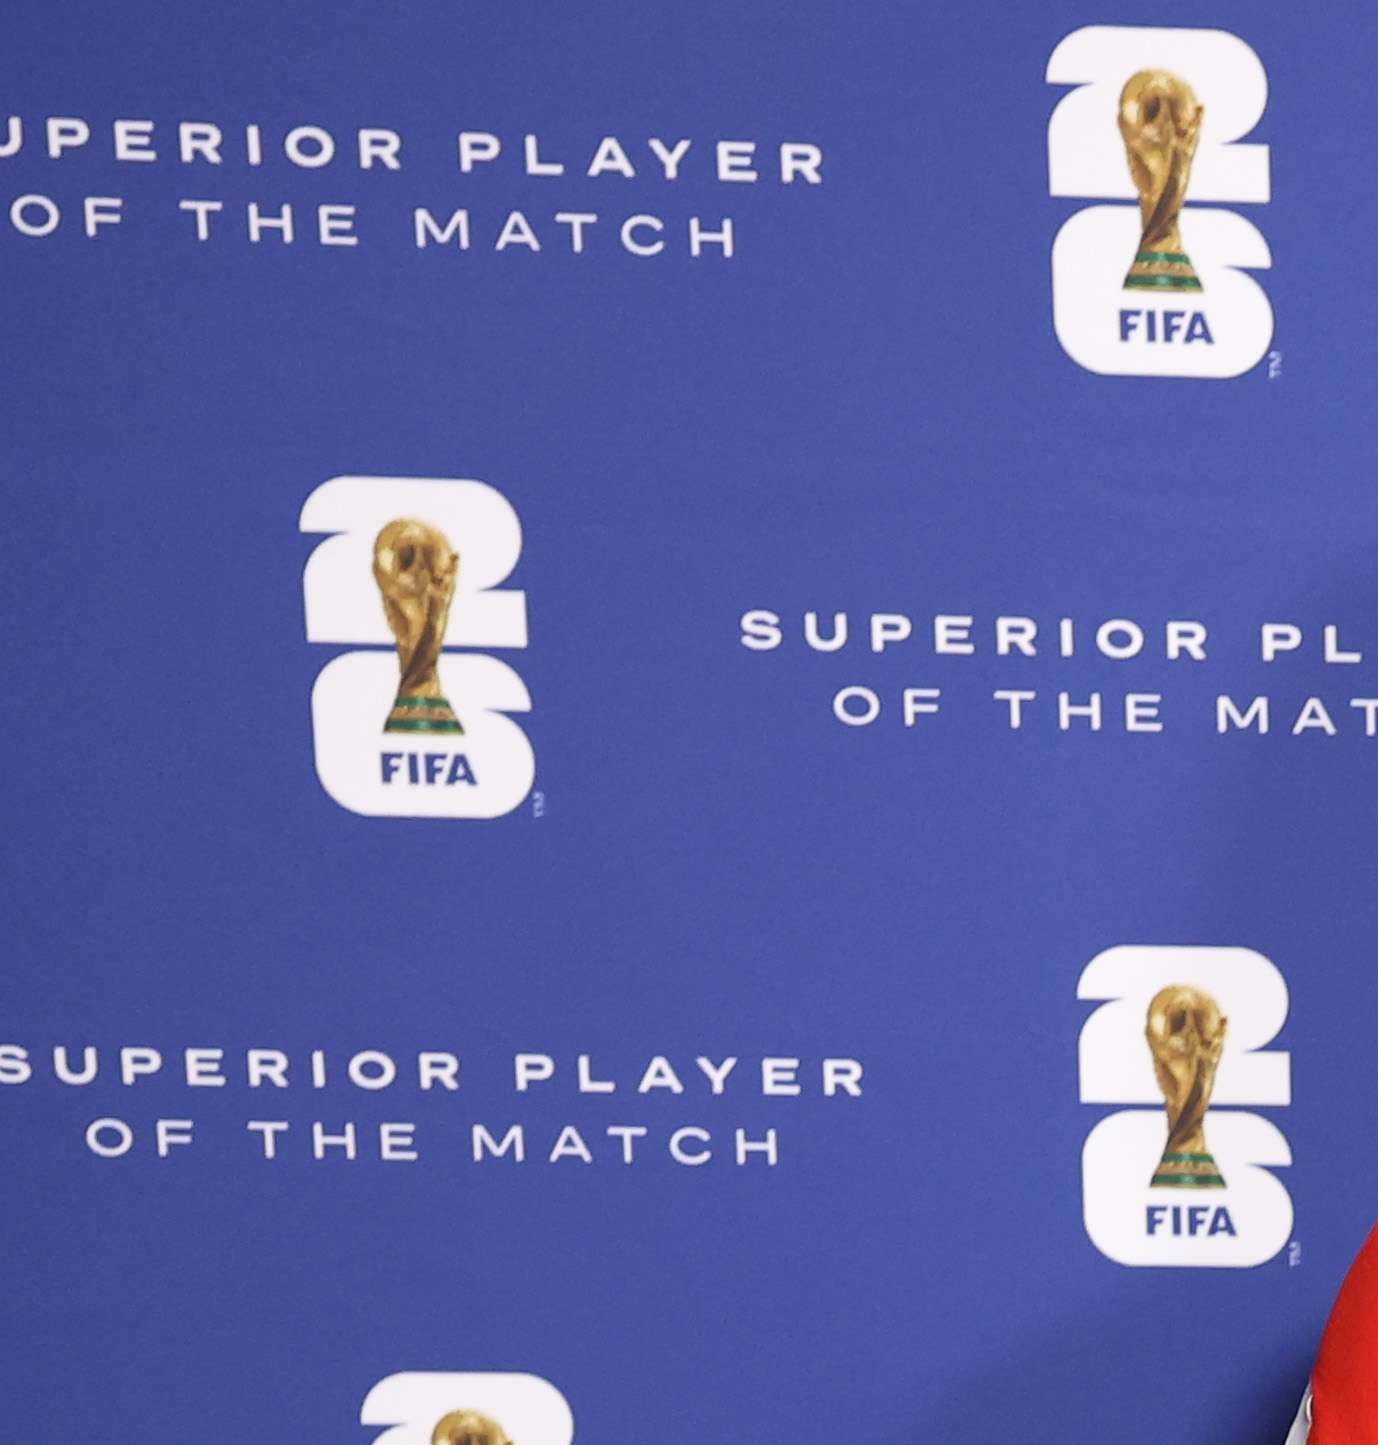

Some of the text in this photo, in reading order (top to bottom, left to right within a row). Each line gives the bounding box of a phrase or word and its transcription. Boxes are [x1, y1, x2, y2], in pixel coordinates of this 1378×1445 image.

[457, 130, 824, 186] PLAYER
[8, 192, 735, 260] OF THE MATCH
[1118, 308, 1215, 345] FIFA
[739, 608, 1209, 662] SUPERIOR
[831, 684, 942, 729] OF
[991, 688, 1165, 734] THE
[379, 751, 478, 787] FIFA
[0, 1043, 865, 1098] SUPERIOR PLAYER
[84, 1116, 779, 1167] OF THE MATCH
[1145, 1204, 1238, 1238] FIFA
